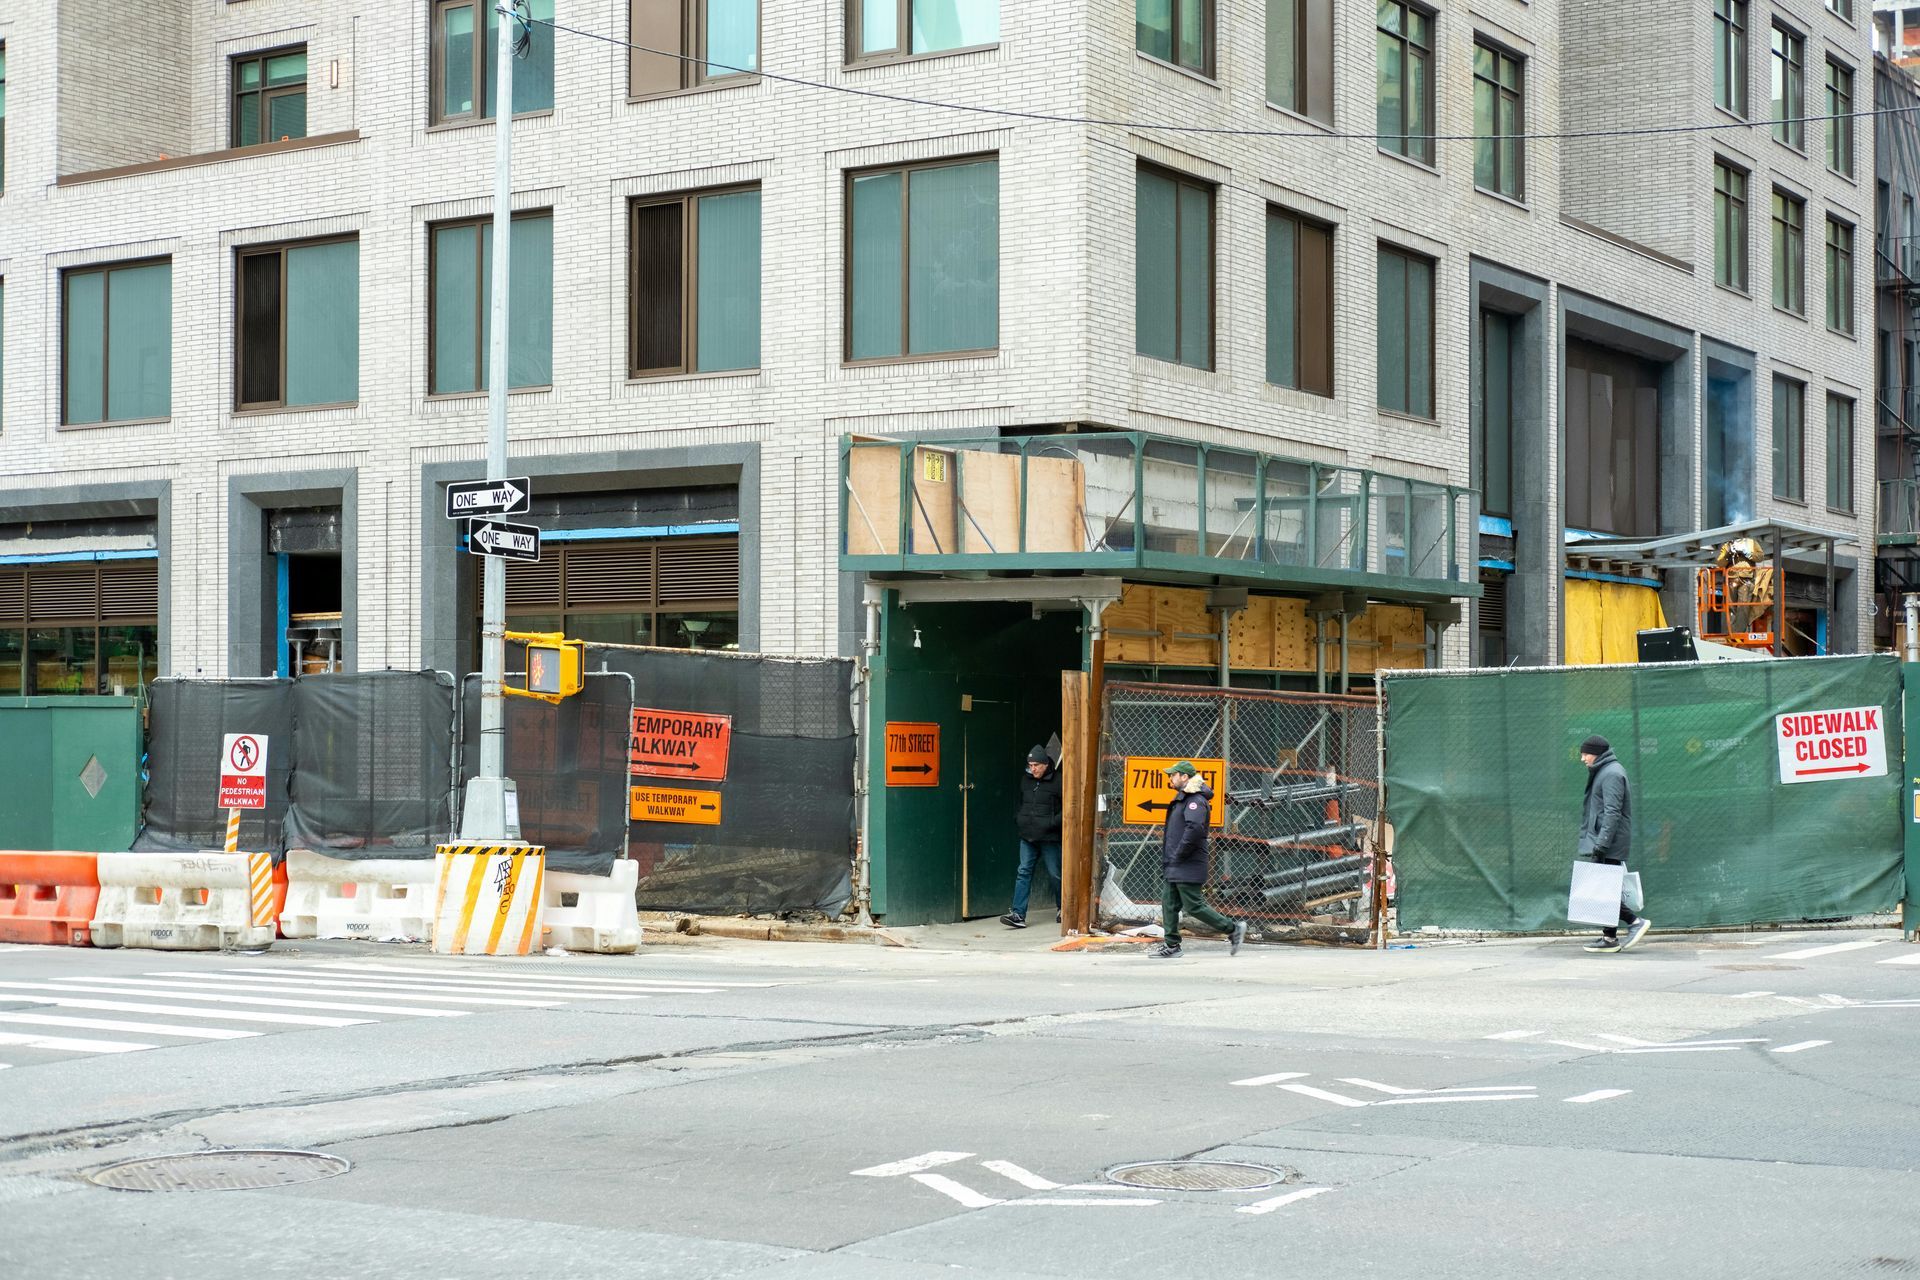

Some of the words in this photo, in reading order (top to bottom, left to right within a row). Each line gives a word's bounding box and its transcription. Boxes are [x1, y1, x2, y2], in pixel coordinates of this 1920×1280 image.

[456, 493, 477, 507] ONE
[492, 489, 515, 504] WAY
[481, 530, 500, 545] ONE
[512, 535, 531, 549] WAY
[633, 715, 724, 739] EMPORARY
[1782, 709, 1878, 738] SIDEWALK
[631, 736, 698, 758] ALKWAY
[889, 733, 907, 753] 77th
[908, 733, 935, 753] STREET
[1795, 736, 1868, 762] CLOSED
[237, 777, 248, 785] NO
[1133, 768, 1163, 789] 77th
[221, 787, 264, 796] PEDESTRIAN
[635, 791, 650, 803] USE
[652, 793, 698, 806] TEMPORARY
[223, 797, 259, 806] WALKWAY
[647, 805, 686, 817] WALKWAY
